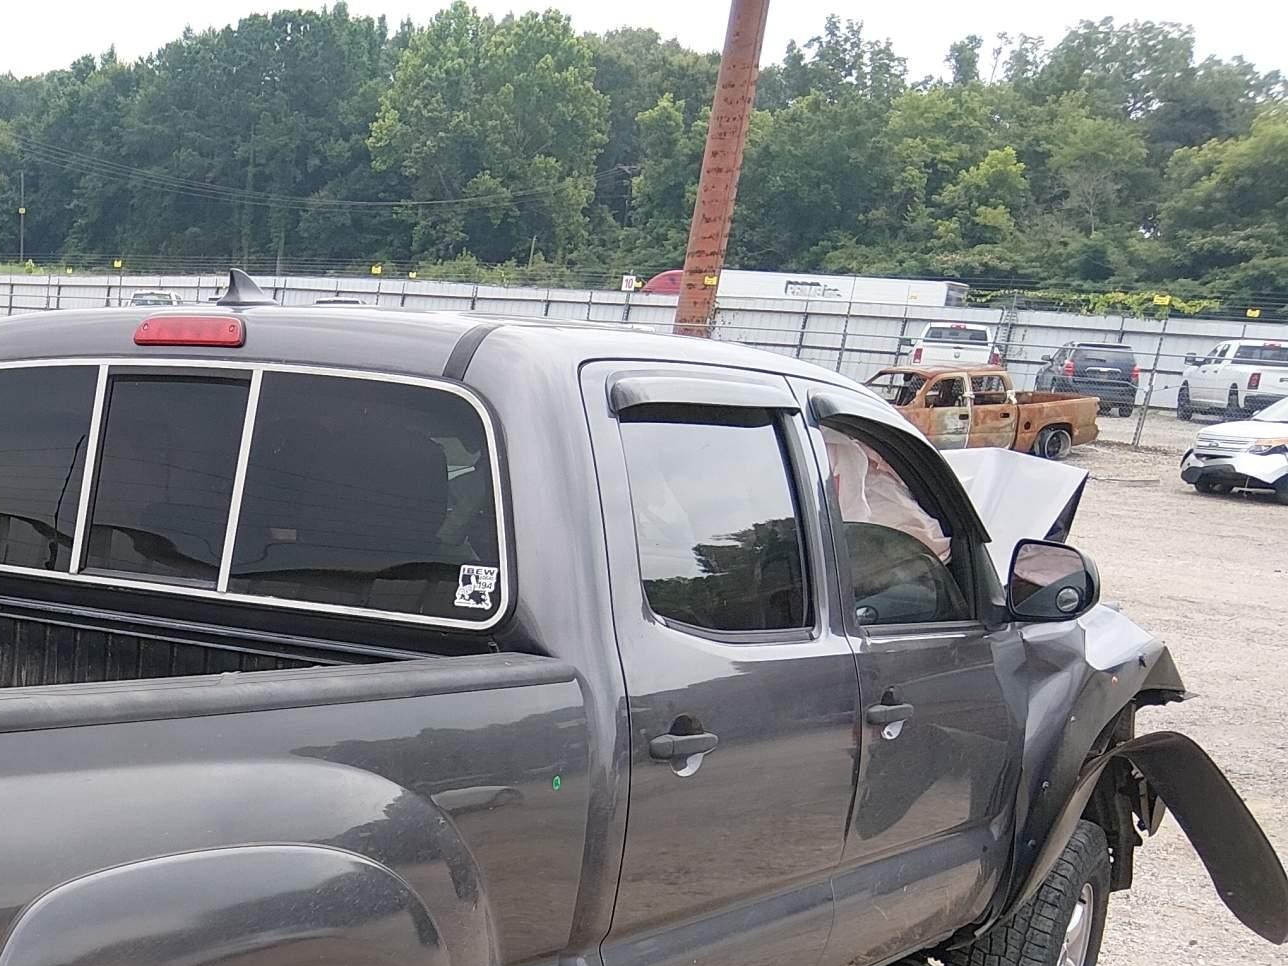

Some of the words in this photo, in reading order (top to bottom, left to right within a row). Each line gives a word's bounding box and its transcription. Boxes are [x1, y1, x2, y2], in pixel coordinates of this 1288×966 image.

[624, 278, 634, 289] 10
[462, 567, 496, 576] IBEW
[478, 581, 493, 590] 194
